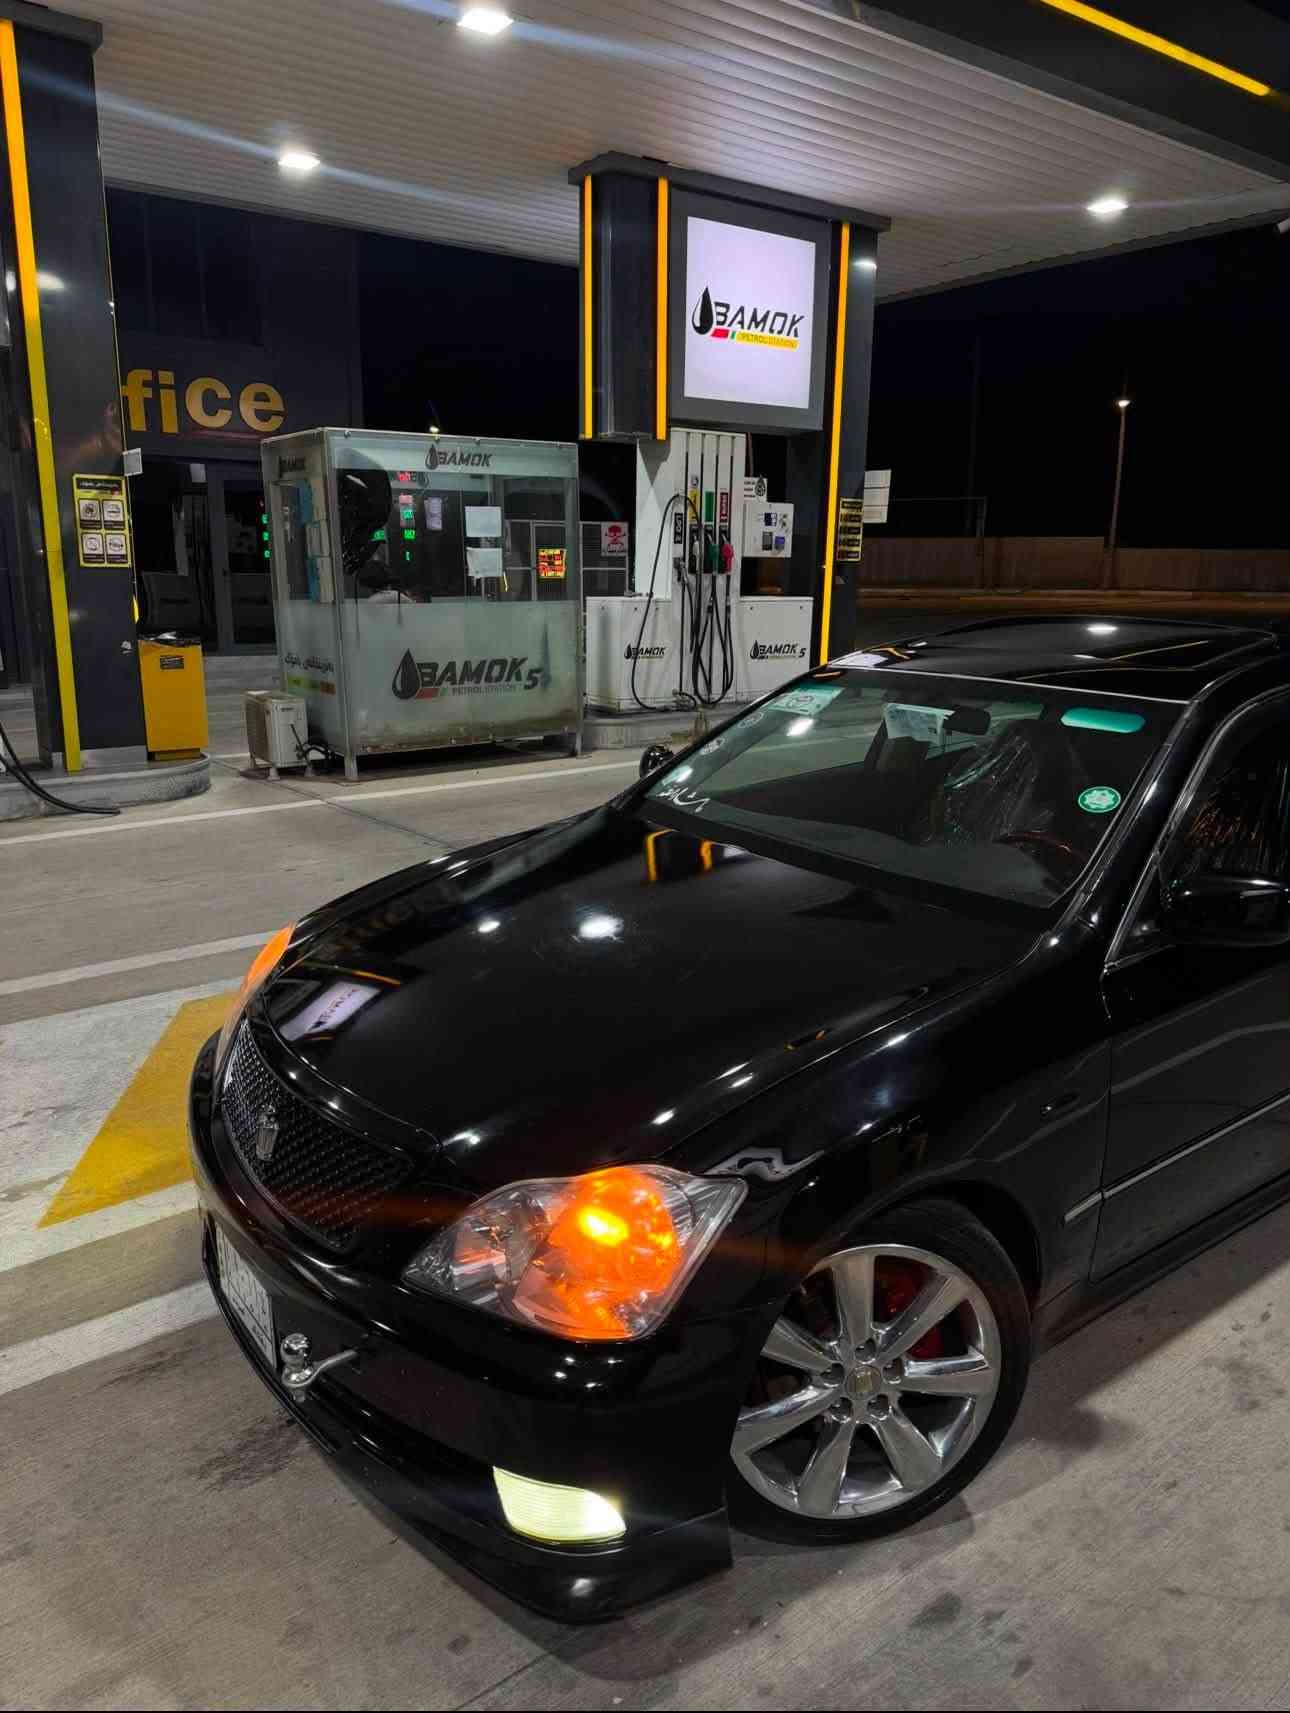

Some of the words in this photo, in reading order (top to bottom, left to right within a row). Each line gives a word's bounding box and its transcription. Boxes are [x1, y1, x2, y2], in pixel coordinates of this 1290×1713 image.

[713, 301, 805, 338] BAMOK
[122, 369, 285, 433] fice
[437, 451, 493, 467] BAMOK
[758, 643, 798, 656] BAMOK
[416, 656, 529, 687] BAMOK
[523, 667, 545, 690] 5
